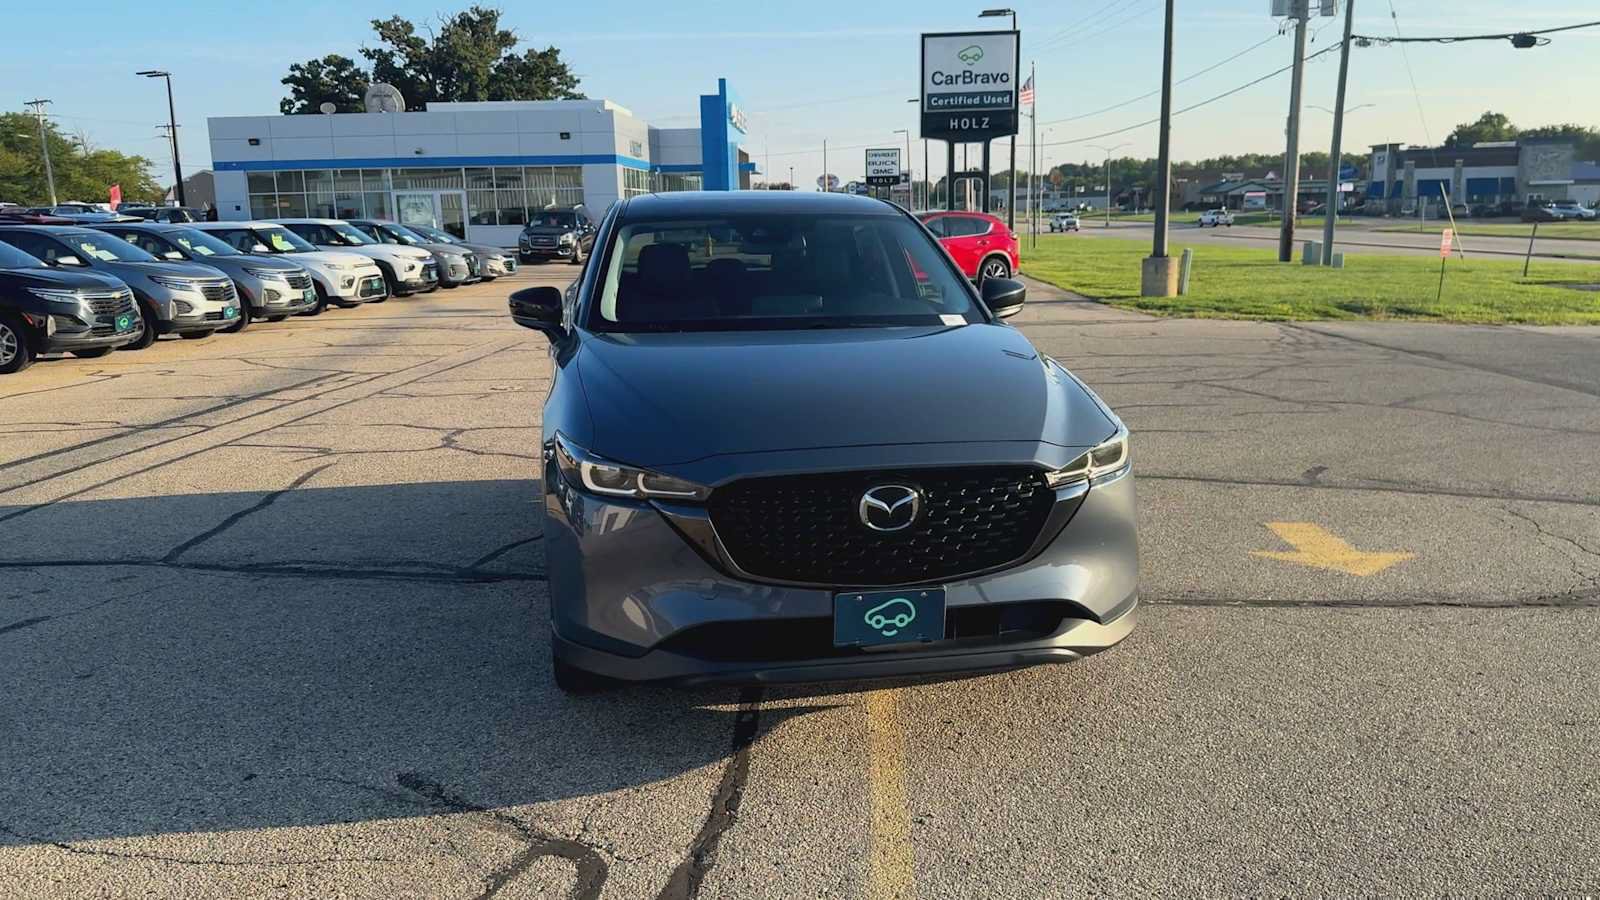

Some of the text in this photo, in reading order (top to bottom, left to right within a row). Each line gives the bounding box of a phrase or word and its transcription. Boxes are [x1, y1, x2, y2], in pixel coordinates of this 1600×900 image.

[931, 70, 1010, 86] CarBravo
[931, 95, 1010, 106] Certified Used
[950, 117, 990, 129] HOLZ
